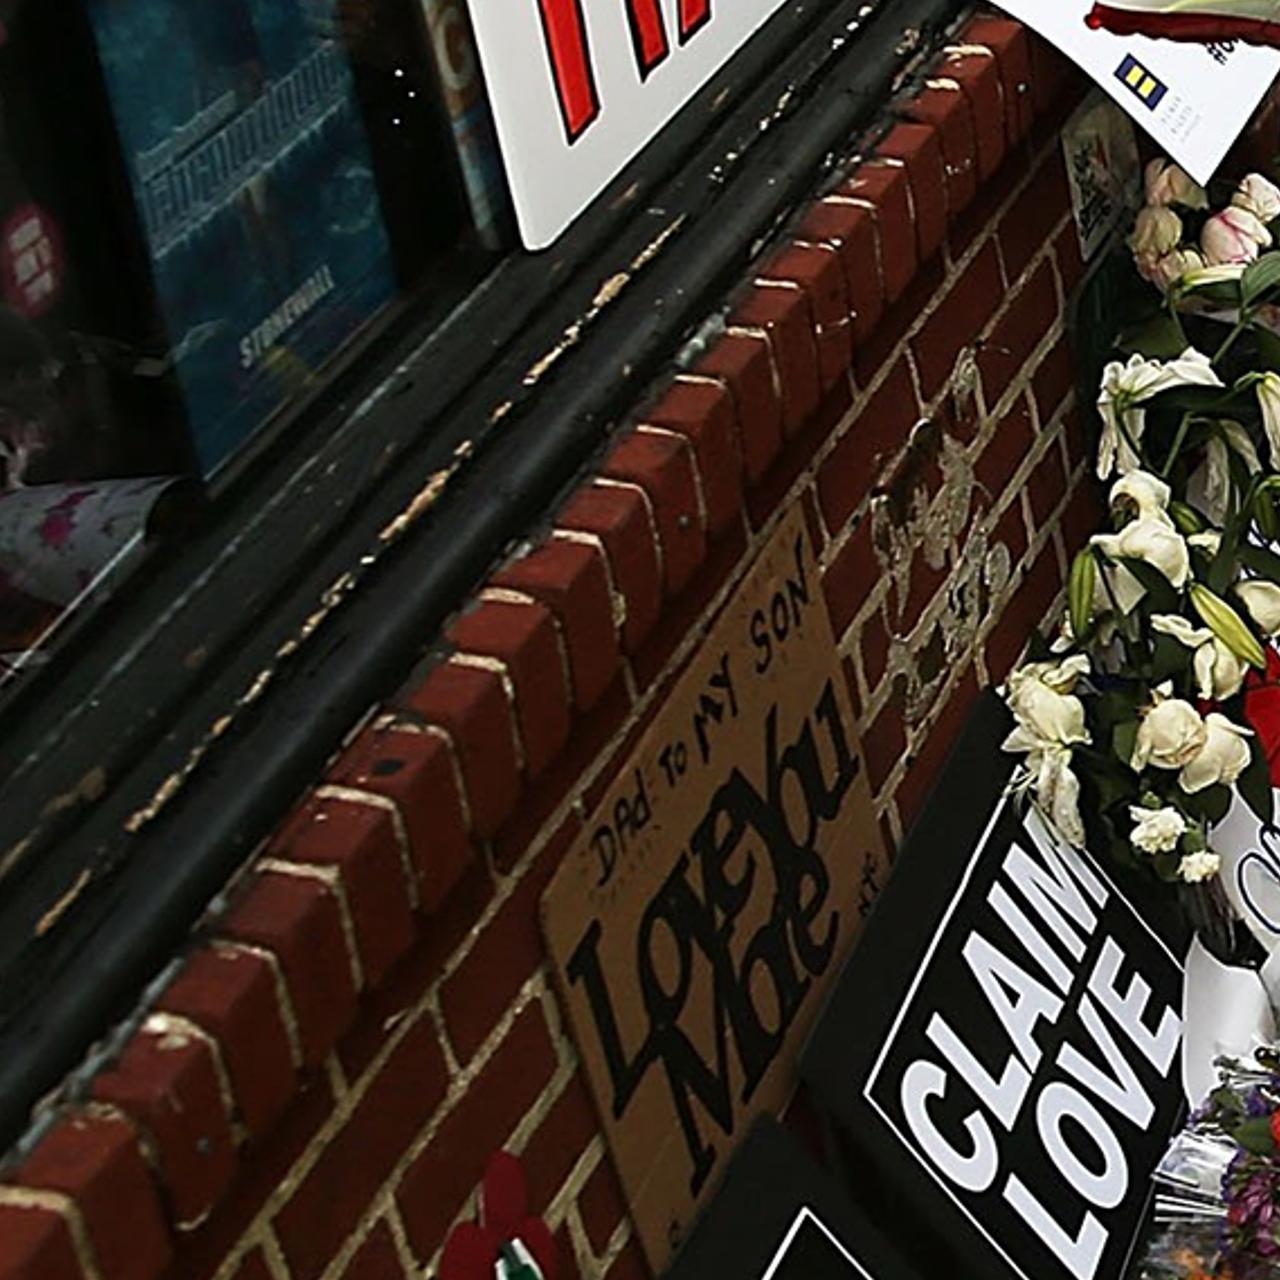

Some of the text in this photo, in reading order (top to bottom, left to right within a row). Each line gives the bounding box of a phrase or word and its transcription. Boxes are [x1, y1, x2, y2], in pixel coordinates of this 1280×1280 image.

[694, 655, 740, 764] MY
[749, 565, 811, 674] SON
[900, 805, 1109, 1194] CLAIM
